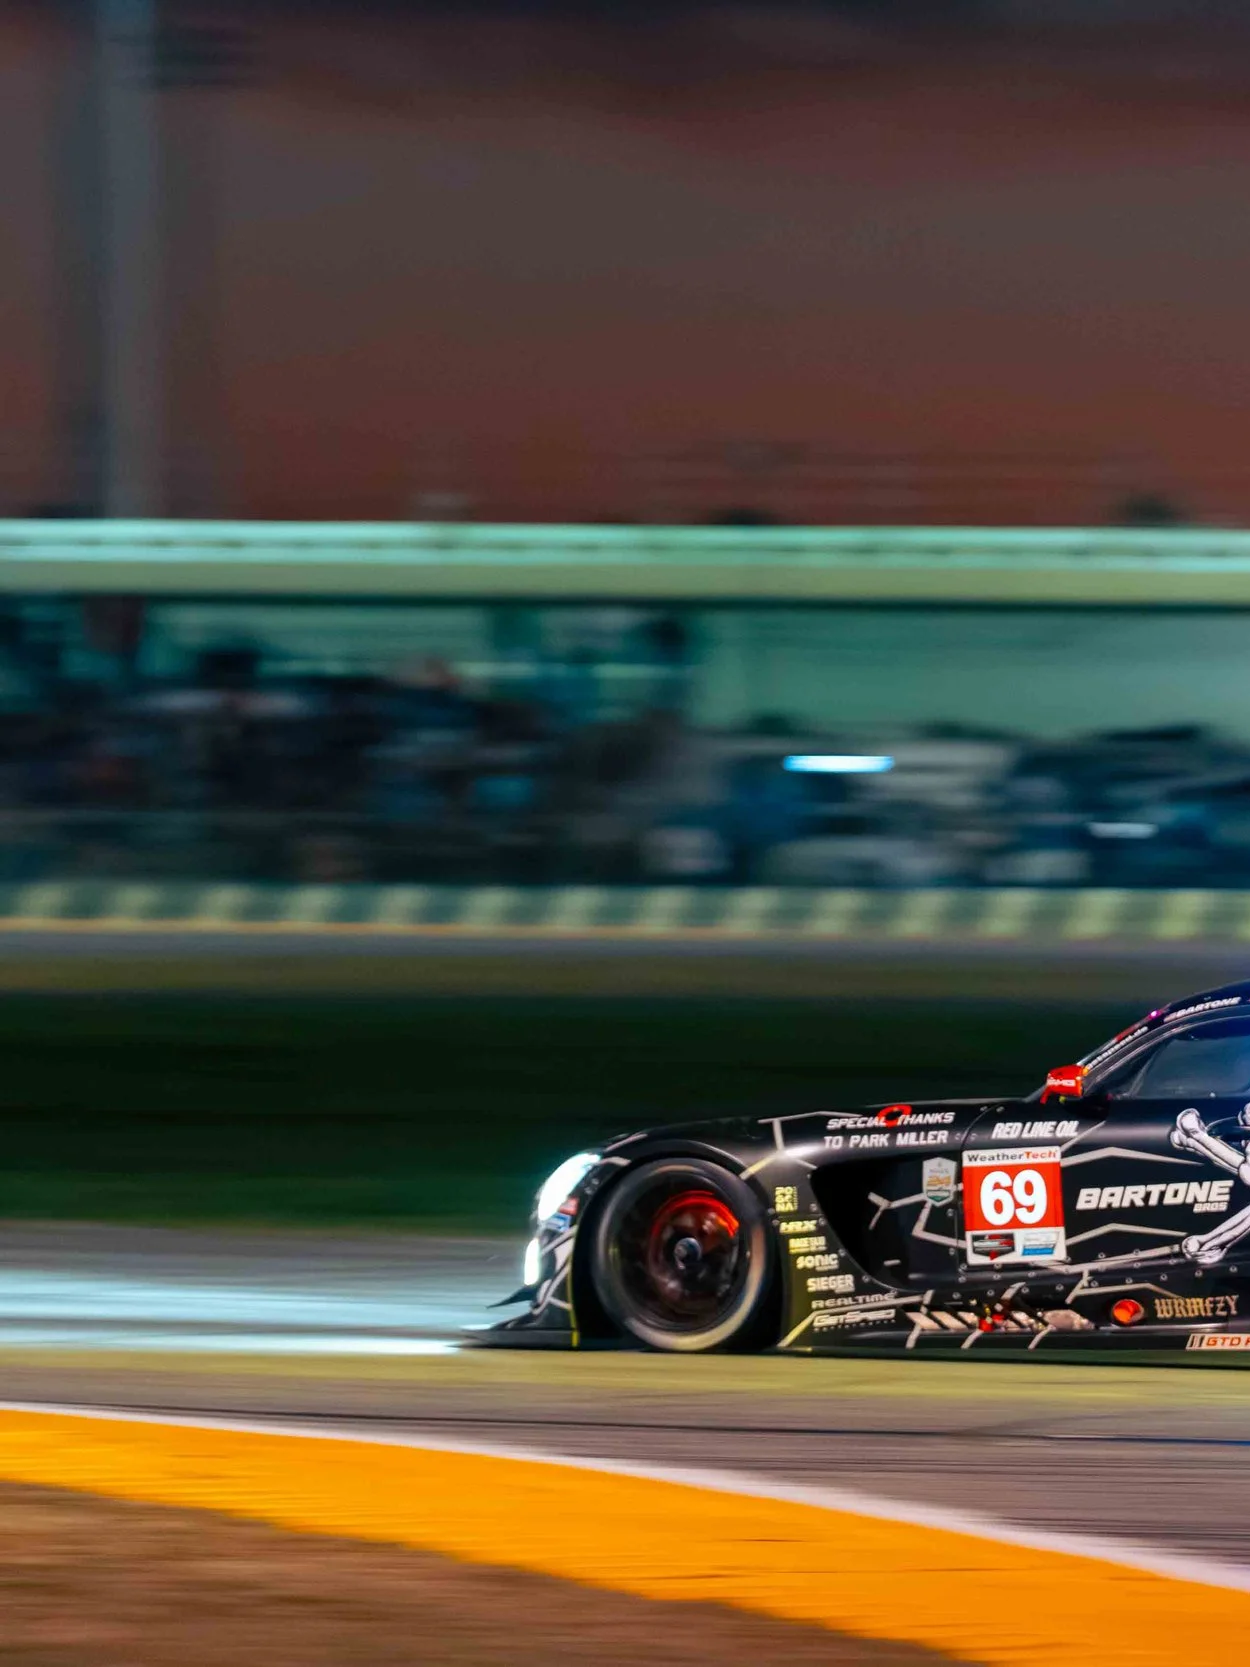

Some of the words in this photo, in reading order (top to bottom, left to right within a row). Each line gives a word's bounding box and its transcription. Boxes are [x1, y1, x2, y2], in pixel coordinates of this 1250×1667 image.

[826, 1115, 887, 1130] SPECIAL
[897, 1111, 956, 1125] THANKS
[992, 1122, 1018, 1139] RED
[1022, 1120, 1056, 1138] LINE
[1056, 1120, 1080, 1137] OIL
[824, 1135, 843, 1149] TO
[850, 1133, 889, 1148] PARK
[896, 1130, 948, 1146] MILLER
[967, 1150, 1057, 1163] WeatherTech
[980, 1169, 1047, 1226] 69
[1075, 1180, 1235, 1211] BARTONE
[1193, 1202, 1229, 1214] BROS
[796, 1253, 839, 1270] SONIC
[806, 1274, 855, 1293] SIEGER
[1205, 1336, 1242, 1347] GTD
